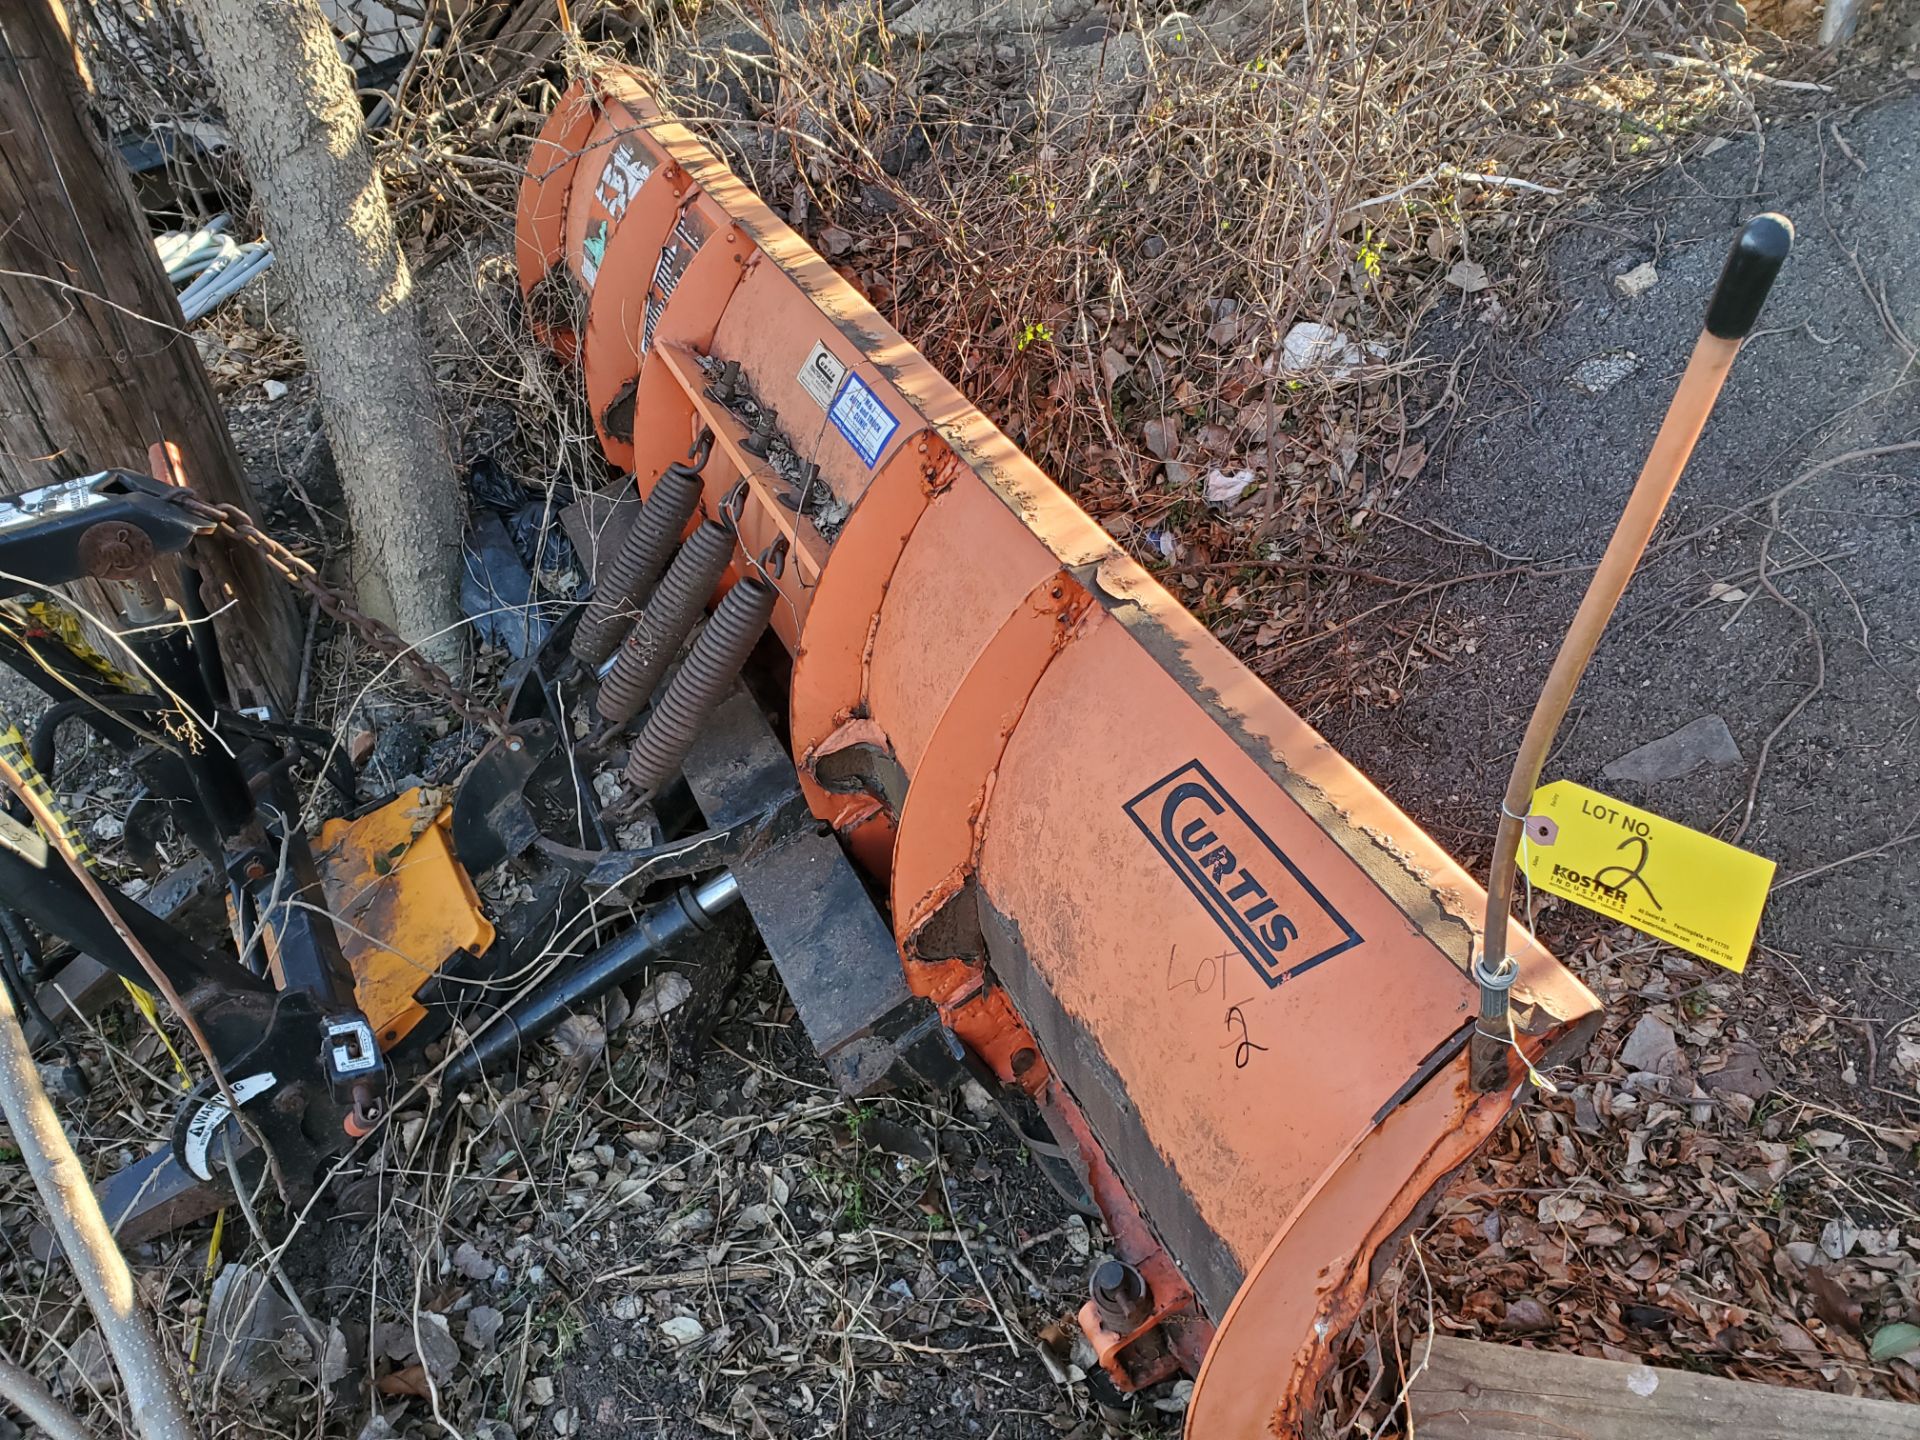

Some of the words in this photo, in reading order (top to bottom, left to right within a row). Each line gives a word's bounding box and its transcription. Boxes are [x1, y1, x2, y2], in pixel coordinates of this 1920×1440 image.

[849, 395, 861, 409] AUTO
[867, 415, 881, 433] TRUCK
[853, 412, 867, 430] CLINIC
[1582, 800, 1619, 824] LOT
[1621, 816, 1653, 840] NO.
[1161, 782, 1298, 967] CURTIS
[1550, 876, 1625, 910] INDUSTRIES
[1552, 864, 1628, 904] KOSTER
[1595, 836, 1662, 911] 2
[1167, 944, 1241, 1000] LOT
[1226, 1006, 1269, 1069] 2
